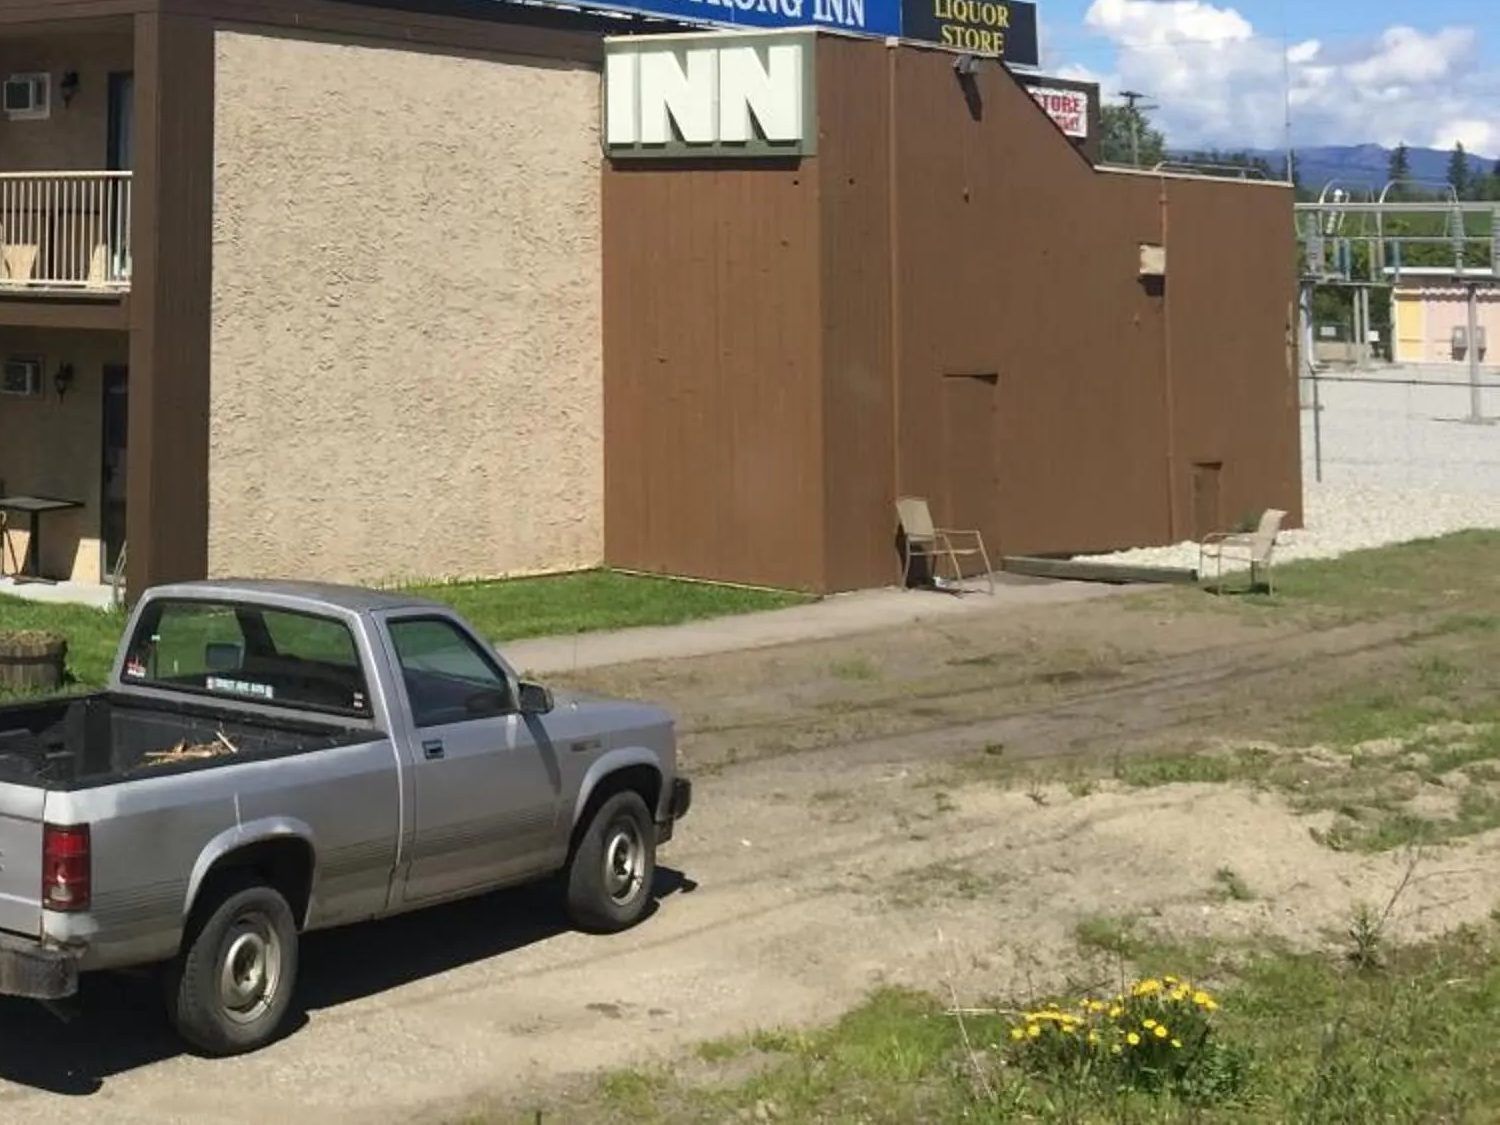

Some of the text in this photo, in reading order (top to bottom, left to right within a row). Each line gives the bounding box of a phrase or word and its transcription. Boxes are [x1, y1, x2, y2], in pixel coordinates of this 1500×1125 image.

[941, 24, 1004, 54] STORE
[607, 45, 803, 147] INN
[1033, 93, 1082, 114] TORE
